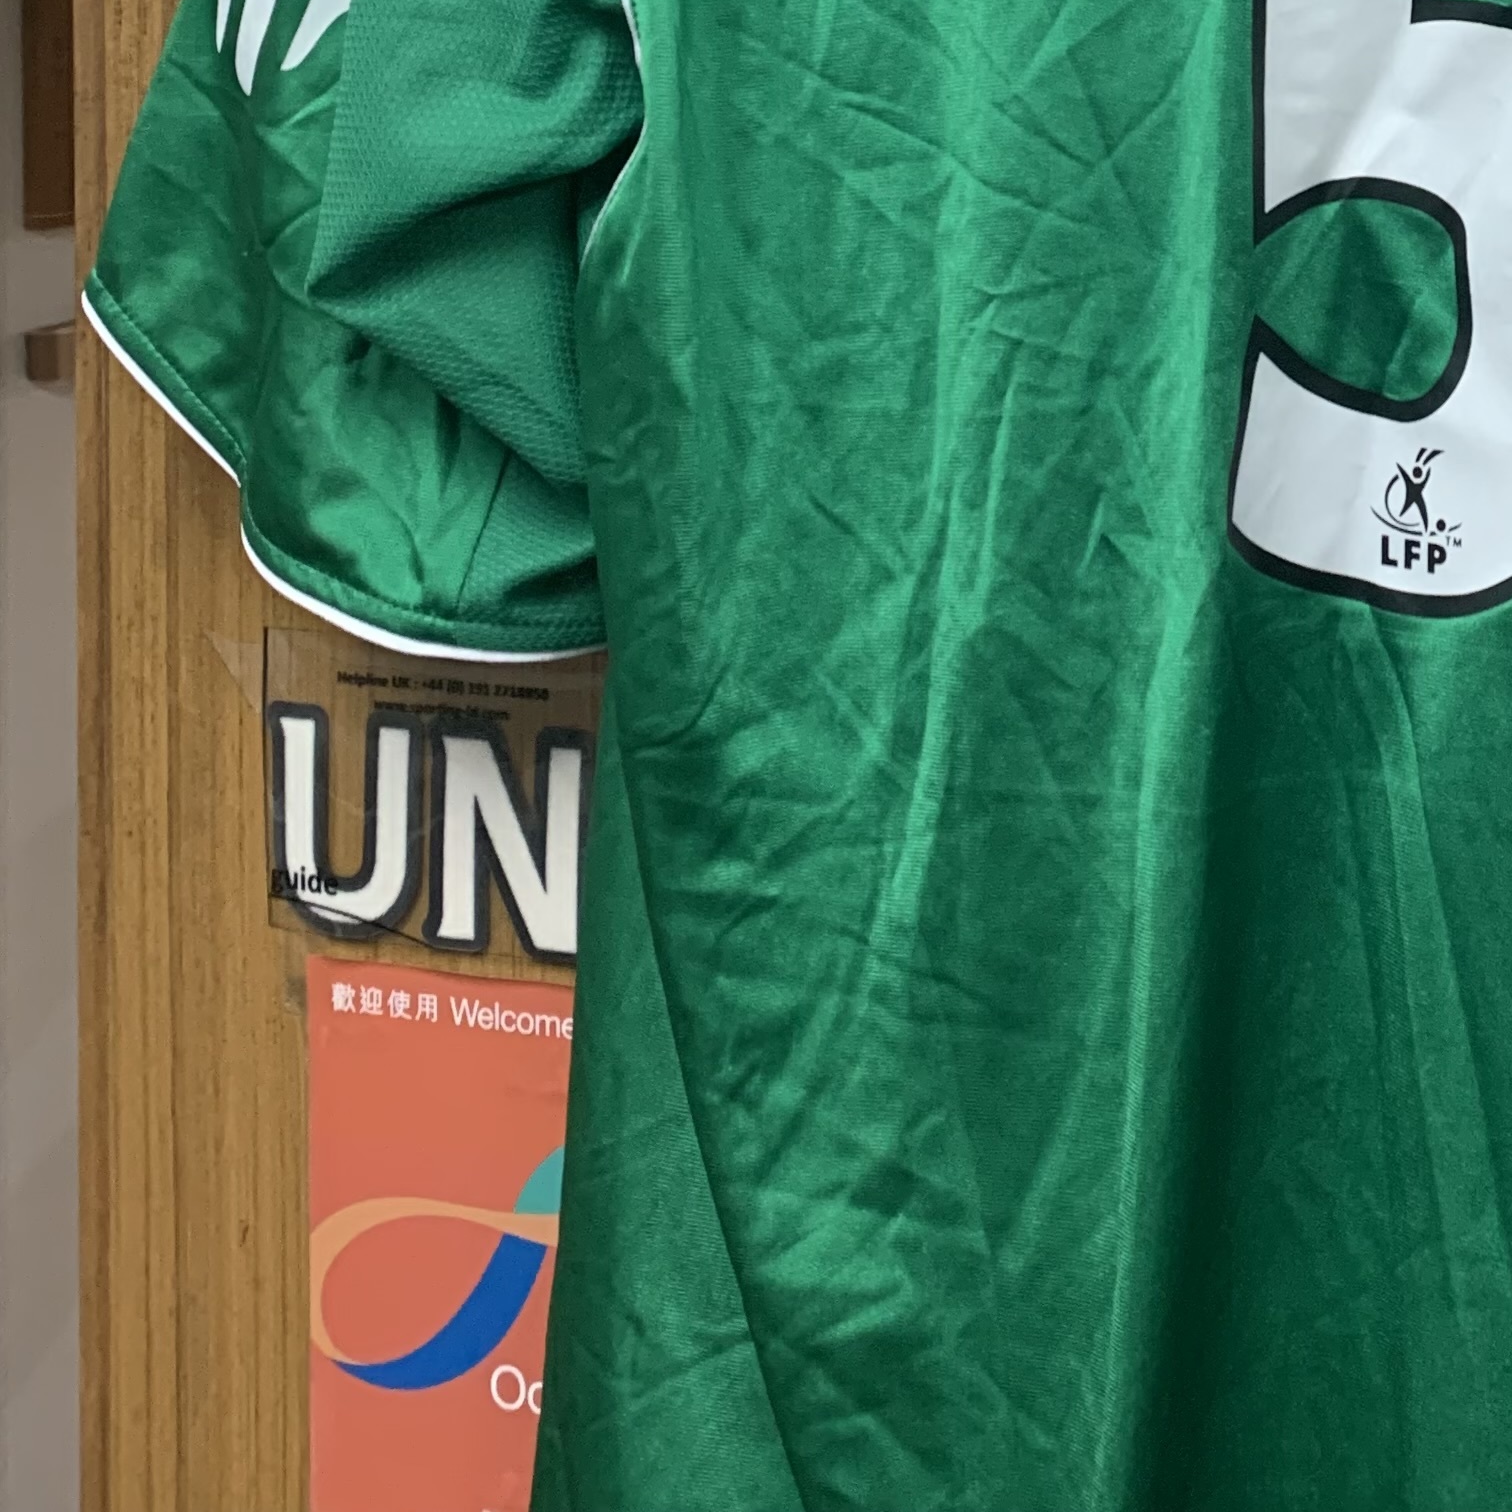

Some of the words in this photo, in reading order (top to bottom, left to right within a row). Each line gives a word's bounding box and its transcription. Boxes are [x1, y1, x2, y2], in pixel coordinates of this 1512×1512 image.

[1381, 534, 1447, 574] LFP
[337, 671, 389, 688] Helpline
[331, 982, 438, 1022] 歡迎使用
[449, 996, 573, 1040] Welcome
